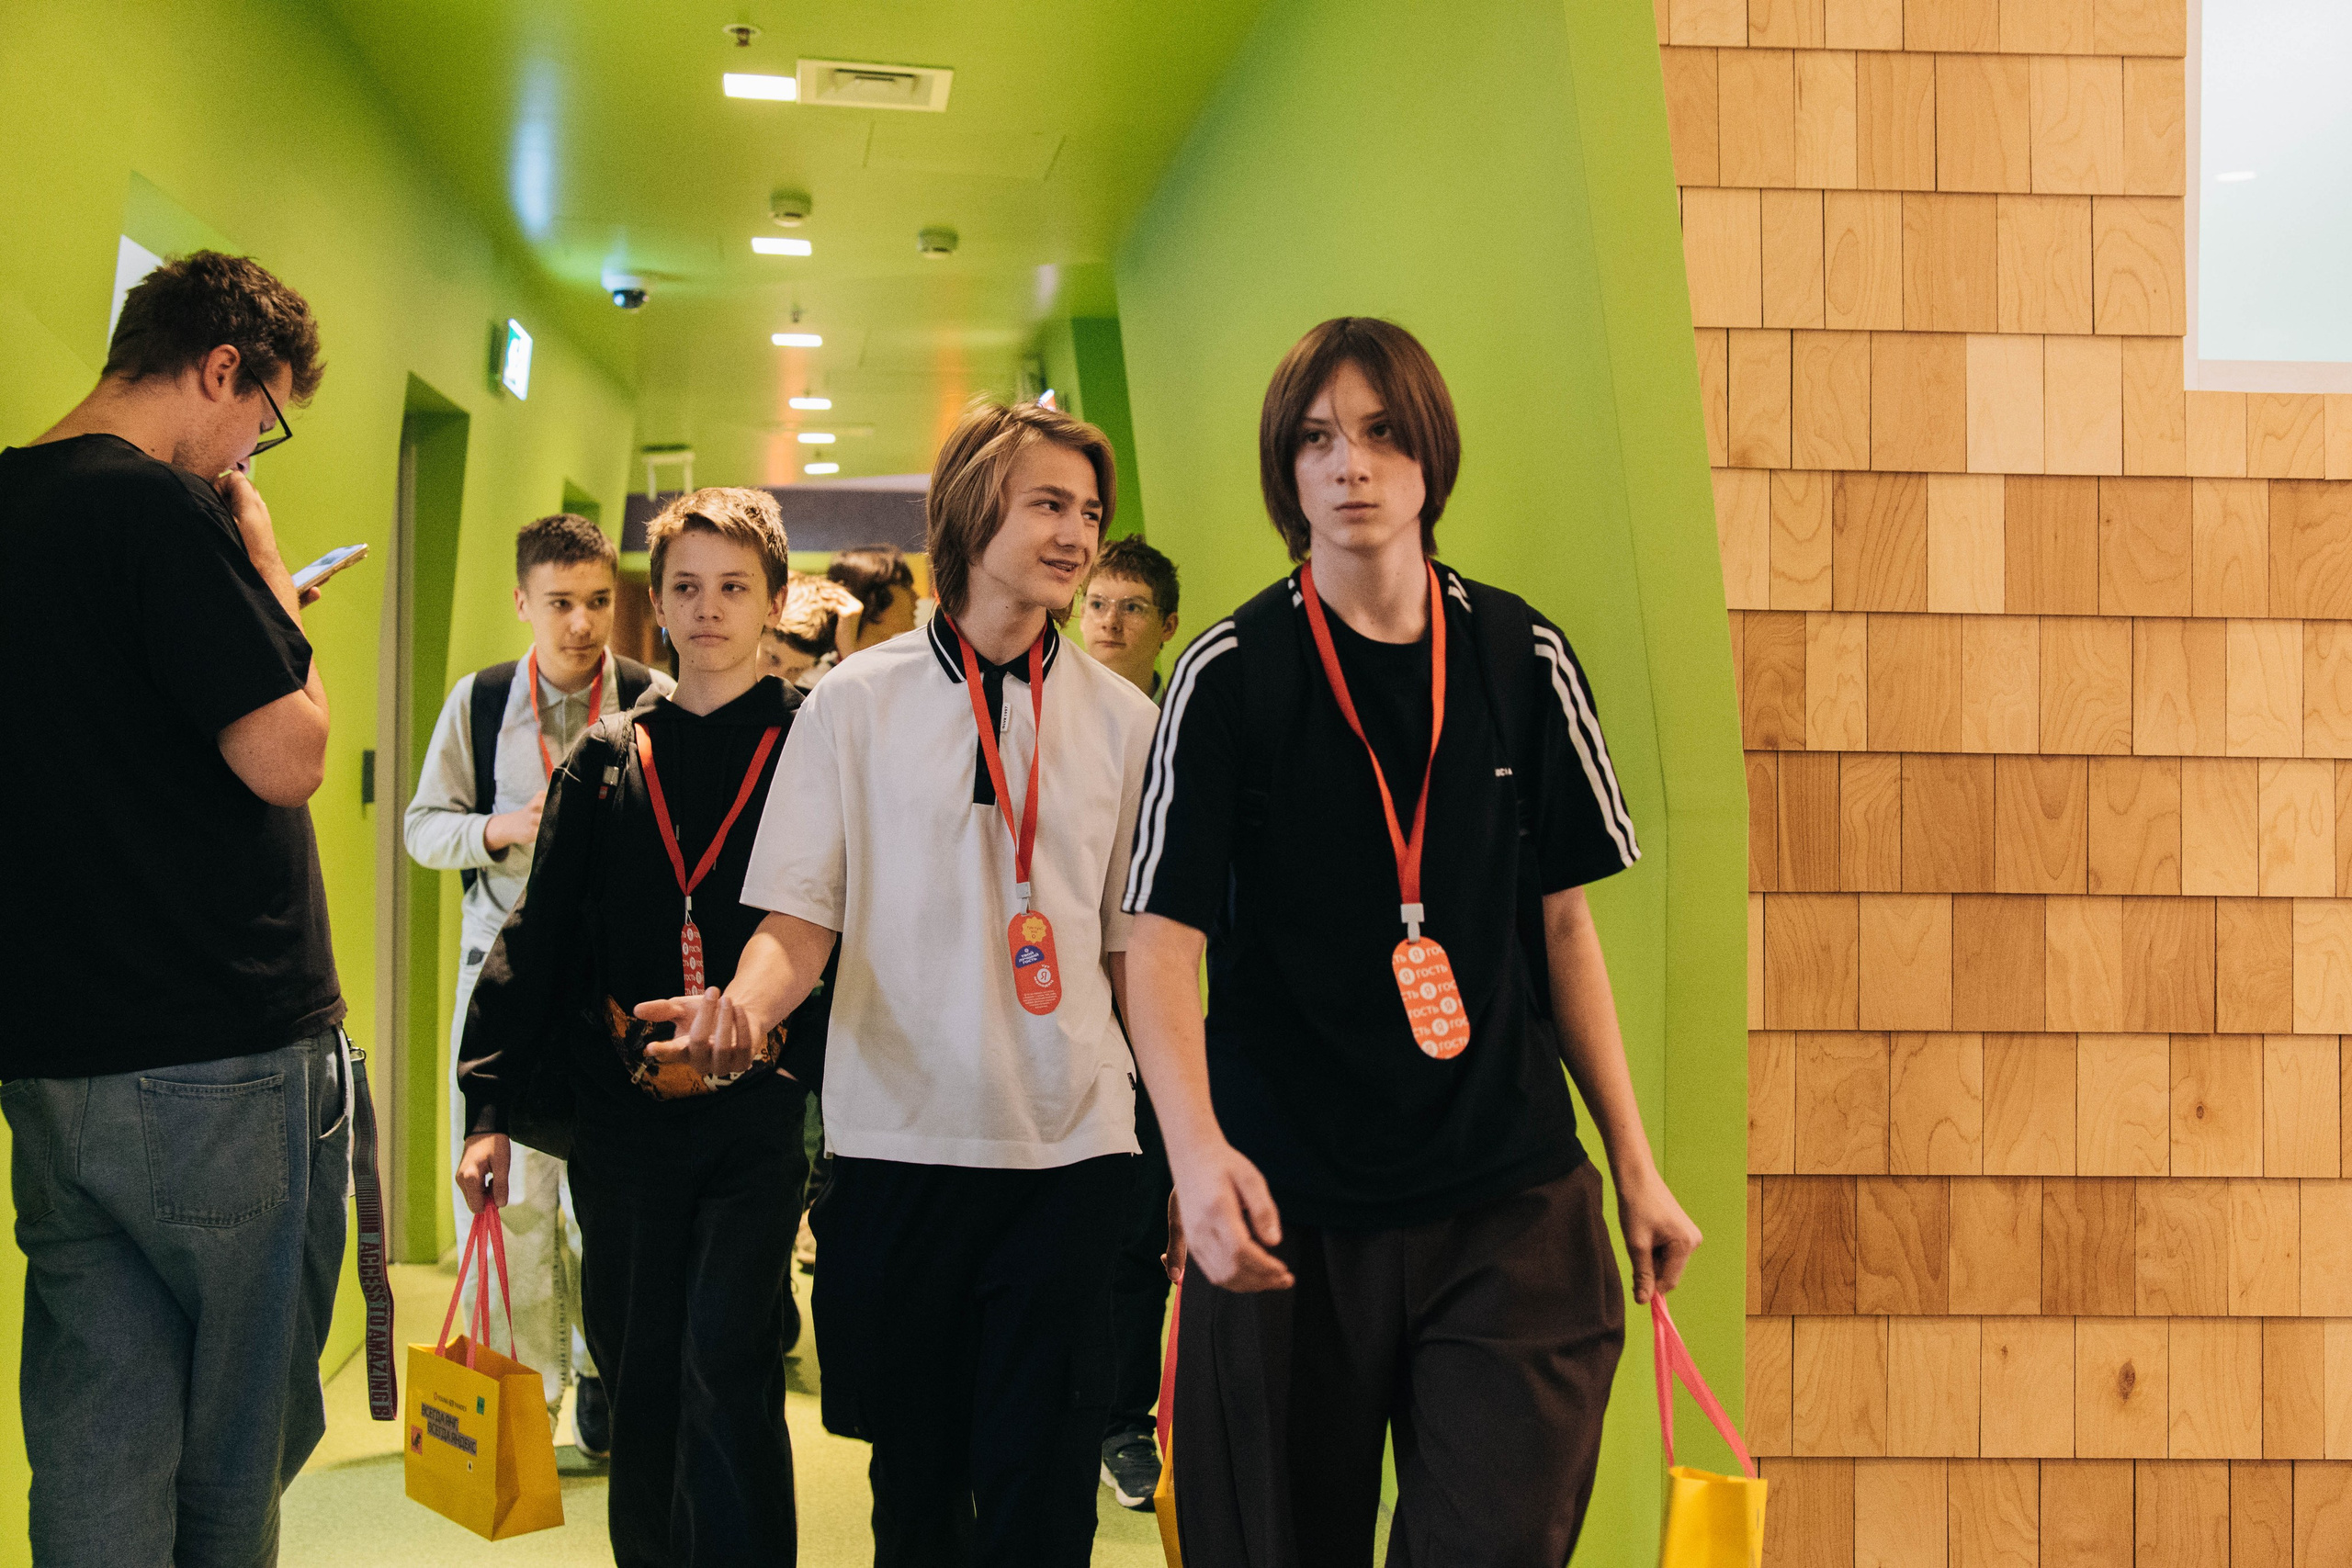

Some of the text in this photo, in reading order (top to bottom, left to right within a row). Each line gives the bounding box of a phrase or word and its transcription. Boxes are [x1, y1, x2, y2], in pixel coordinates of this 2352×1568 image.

[1416, 964, 1449, 978] ГОСТЬ
[359, 1241, 387, 1303] ACCESS
[368, 1303, 388, 1326] TO
[368, 1328, 390, 1403] AMAZING
[427, 1421, 477, 1455] ВСЕГДА ЯНДЕКС
